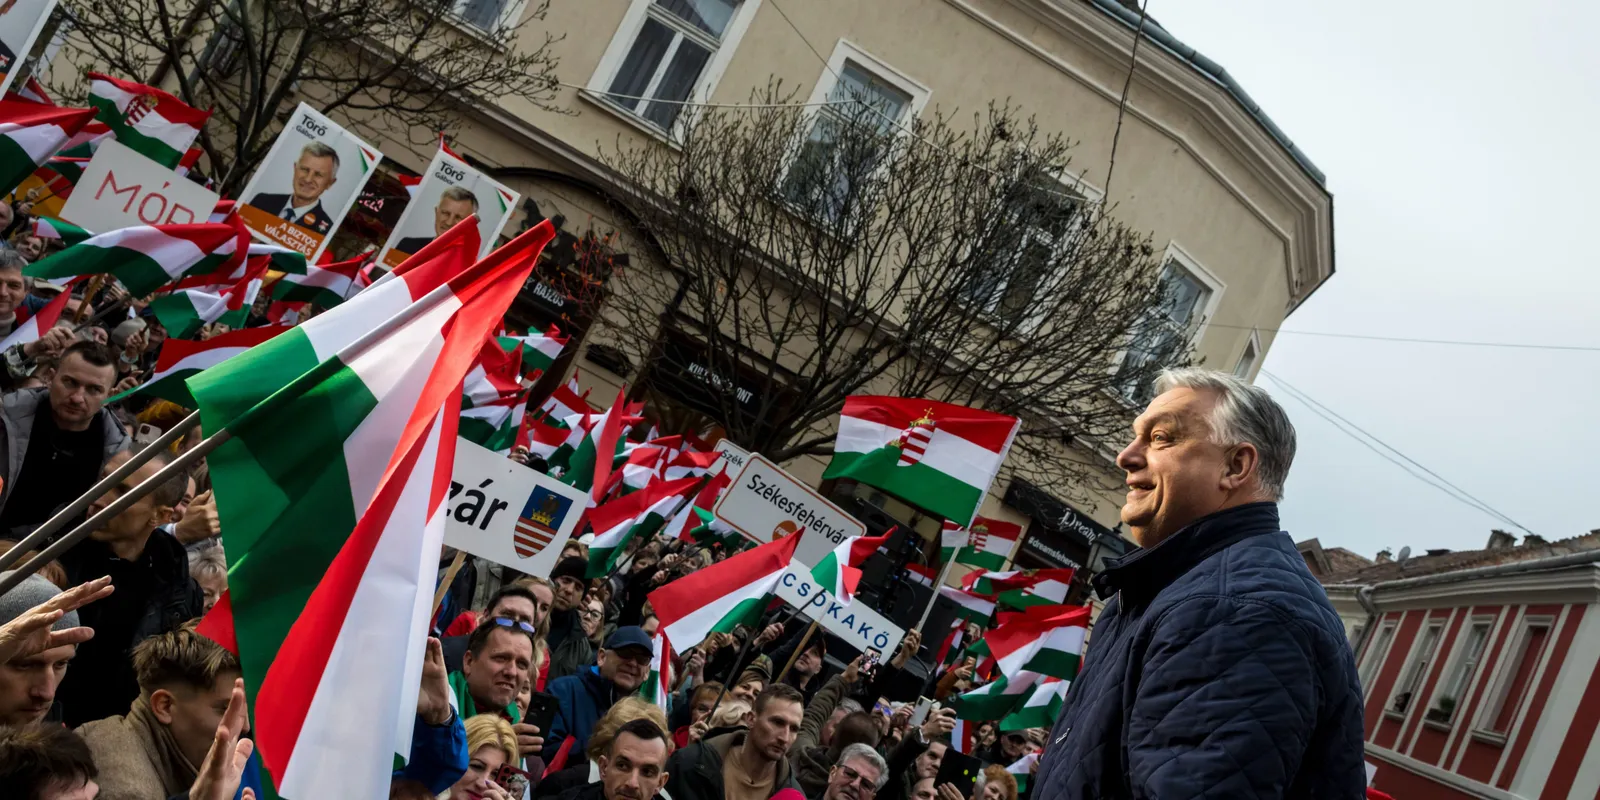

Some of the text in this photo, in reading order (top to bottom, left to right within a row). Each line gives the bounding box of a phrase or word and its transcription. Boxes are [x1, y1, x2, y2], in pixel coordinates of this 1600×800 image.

[302, 114, 328, 136] Törő
[440, 160, 466, 181] Törő
[264, 223, 313, 256] VÁLASZTÁS
[279, 222, 318, 248] A BIZTOS
[747, 474, 850, 545] Székesfehérvár
